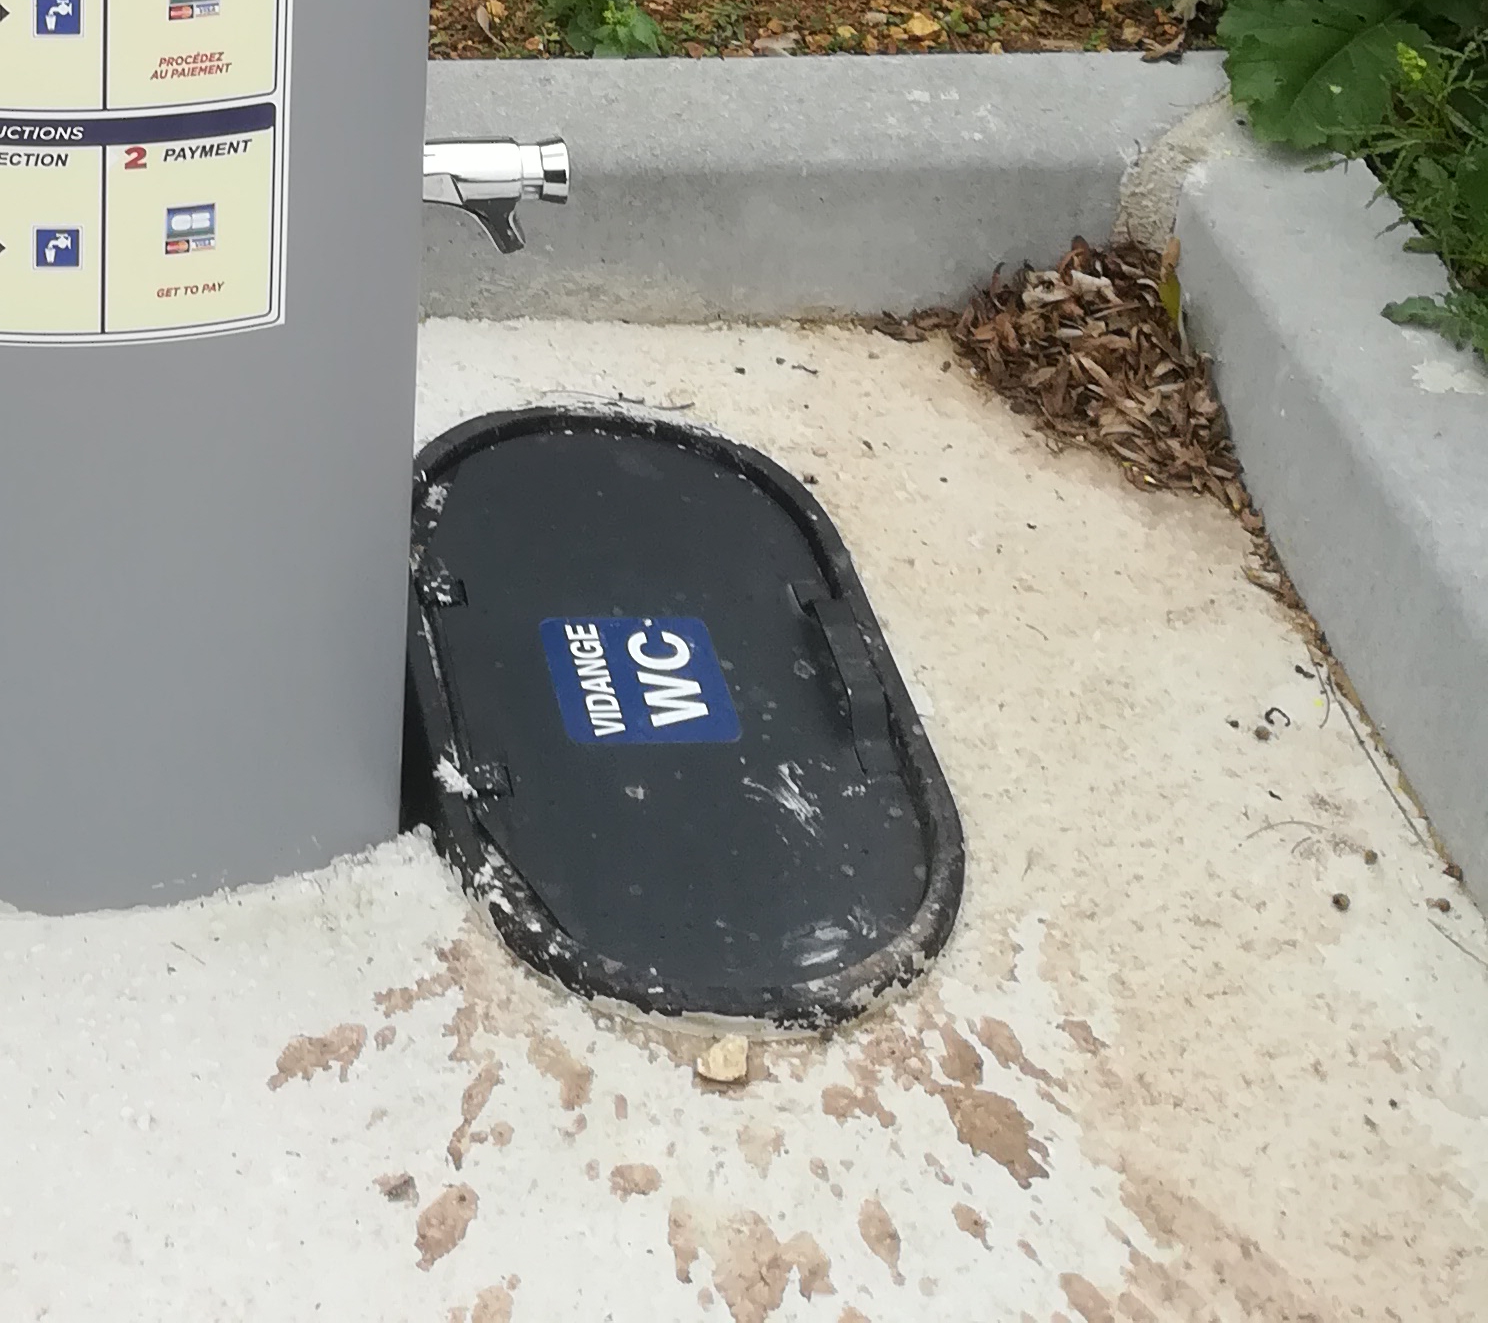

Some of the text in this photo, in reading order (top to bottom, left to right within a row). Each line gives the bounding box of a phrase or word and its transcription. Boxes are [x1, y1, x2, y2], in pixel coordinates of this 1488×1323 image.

[150, 62, 232, 80] AU PAIEMENT
[159, 52, 224, 67] PROCÉDEZ
[124, 139, 253, 170] 2 PAYMENT
[157, 281, 224, 298] GET TO PAY
[564, 623, 626, 737] VIDANGE
[627, 630, 709, 727] WC
